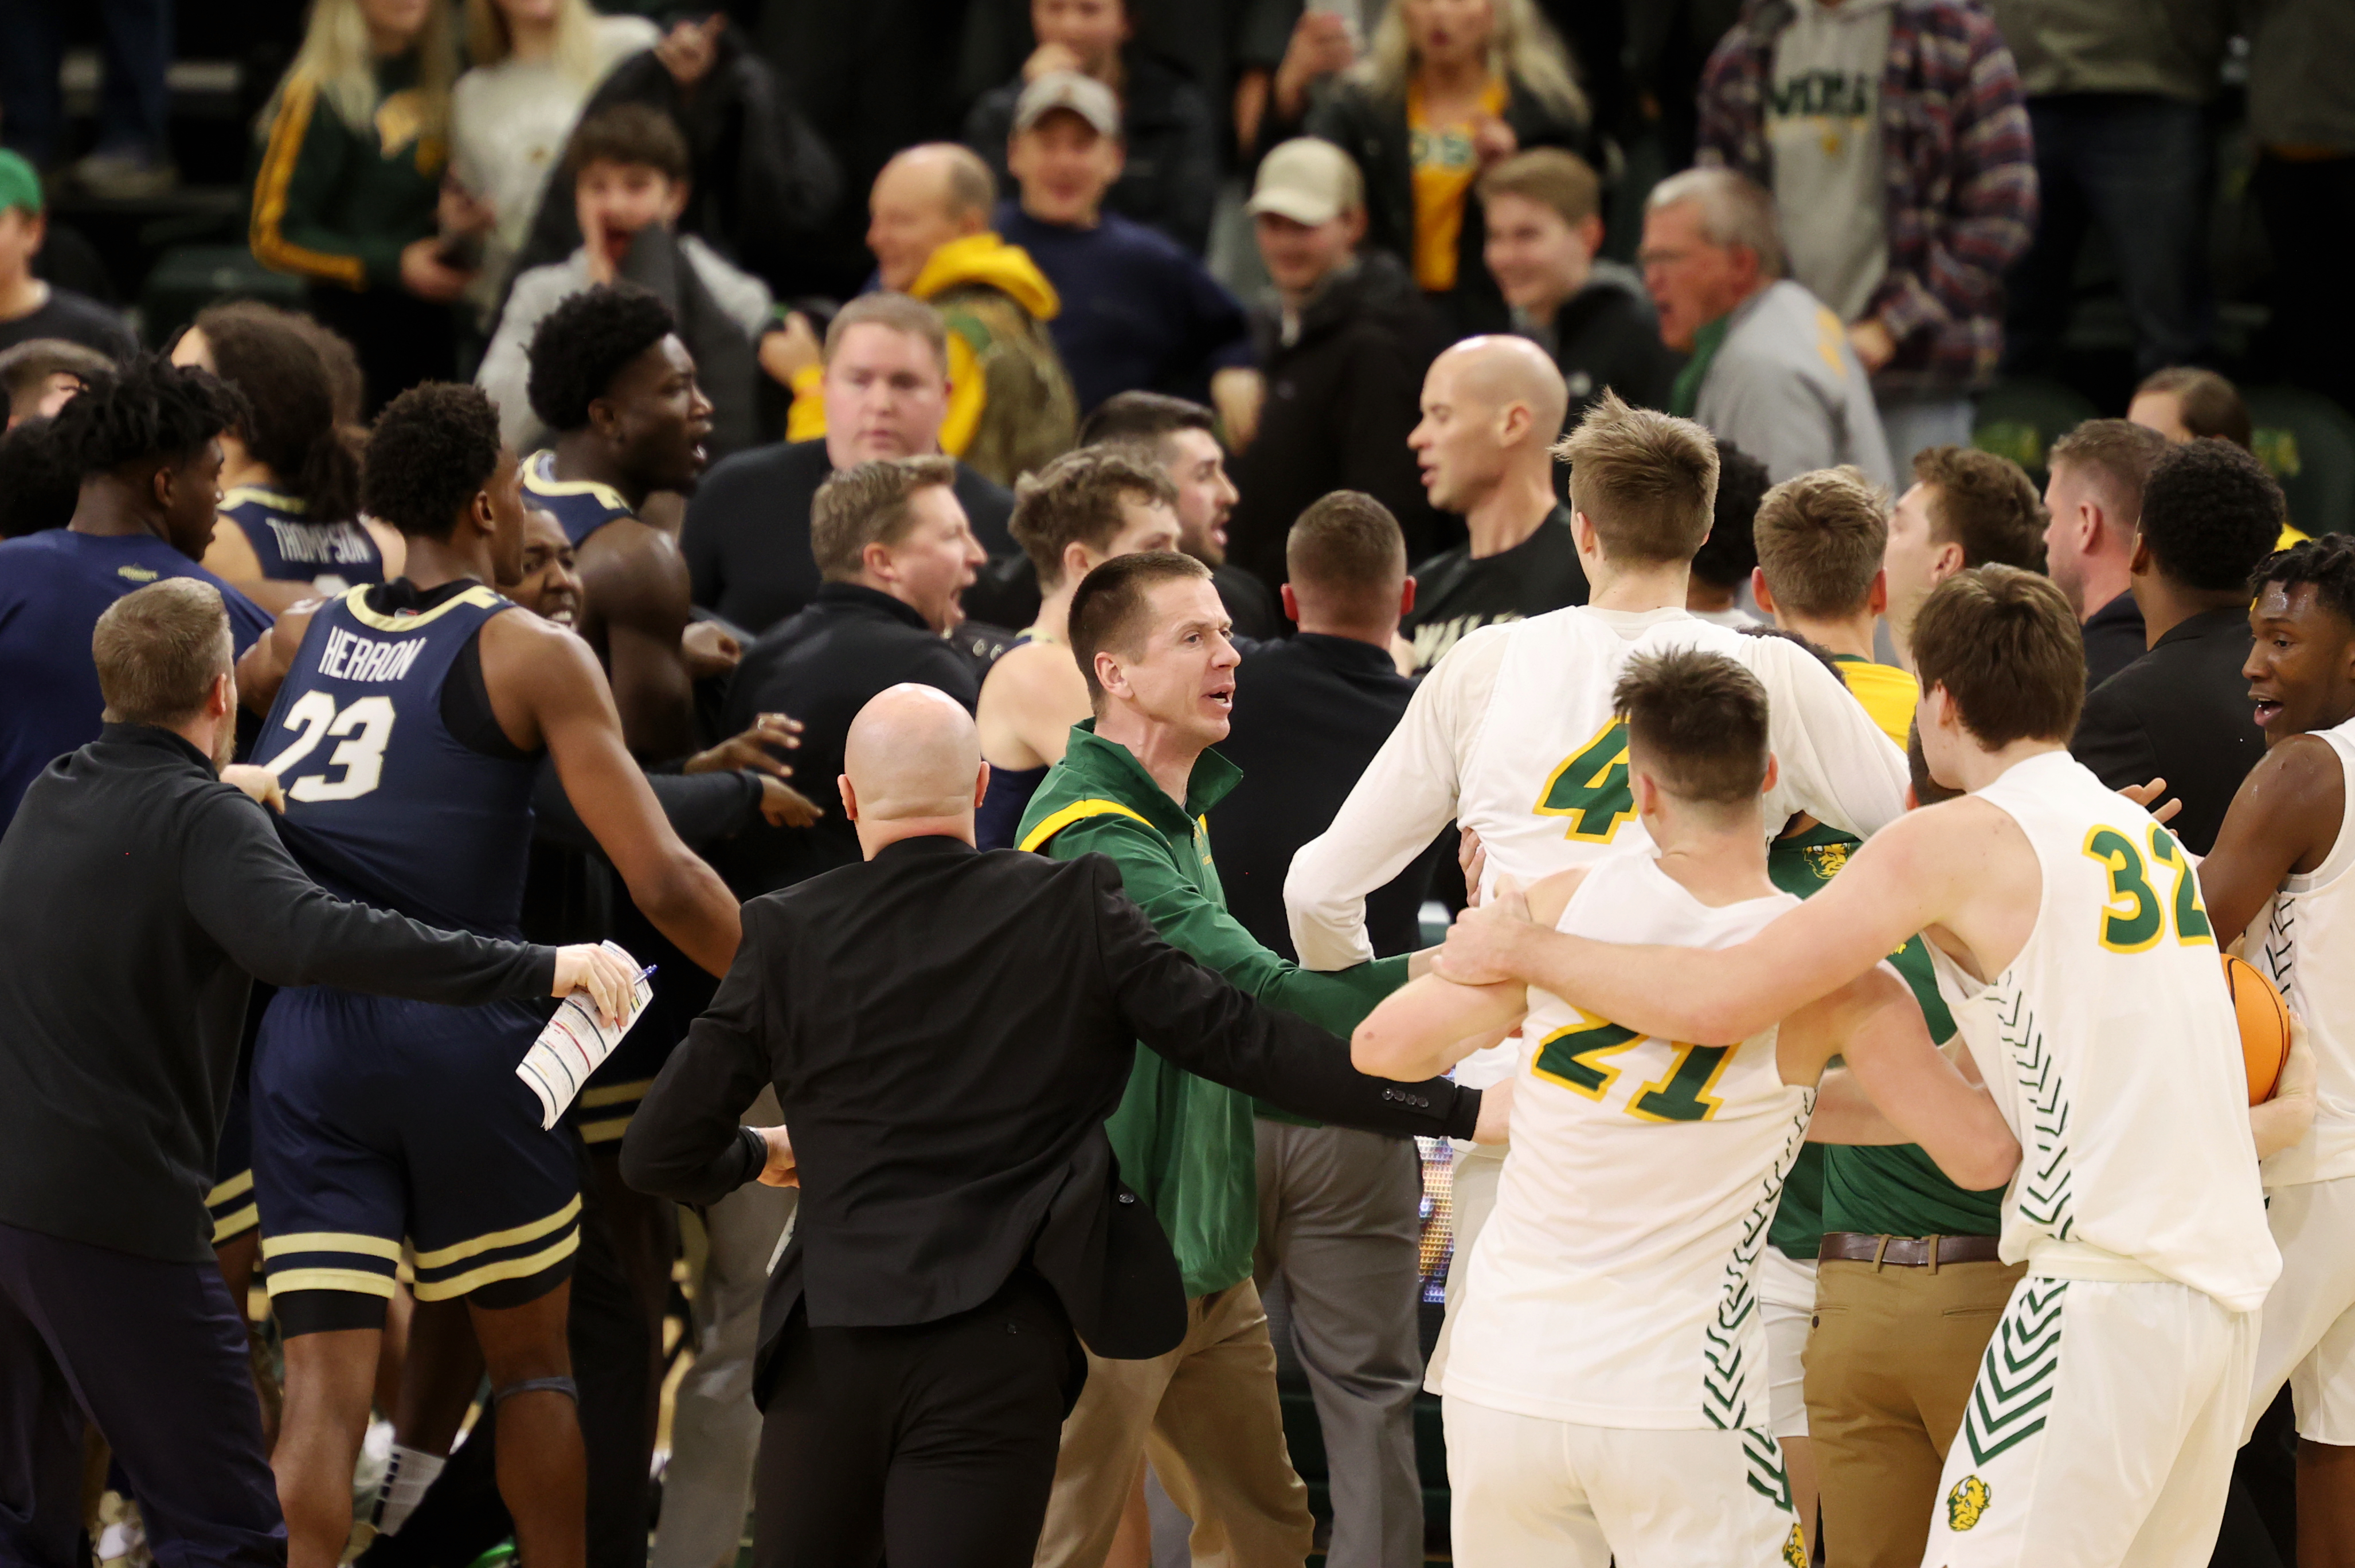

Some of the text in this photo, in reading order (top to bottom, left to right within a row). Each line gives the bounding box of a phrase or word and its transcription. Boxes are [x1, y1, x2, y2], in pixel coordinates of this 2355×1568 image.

[265, 517, 371, 564] THOMPSON
[318, 625, 427, 682] HERRON
[262, 689, 396, 803] 23
[1532, 715, 1638, 844] 4
[2082, 822, 2215, 954] 32
[1531, 1003, 1743, 1122] 21
